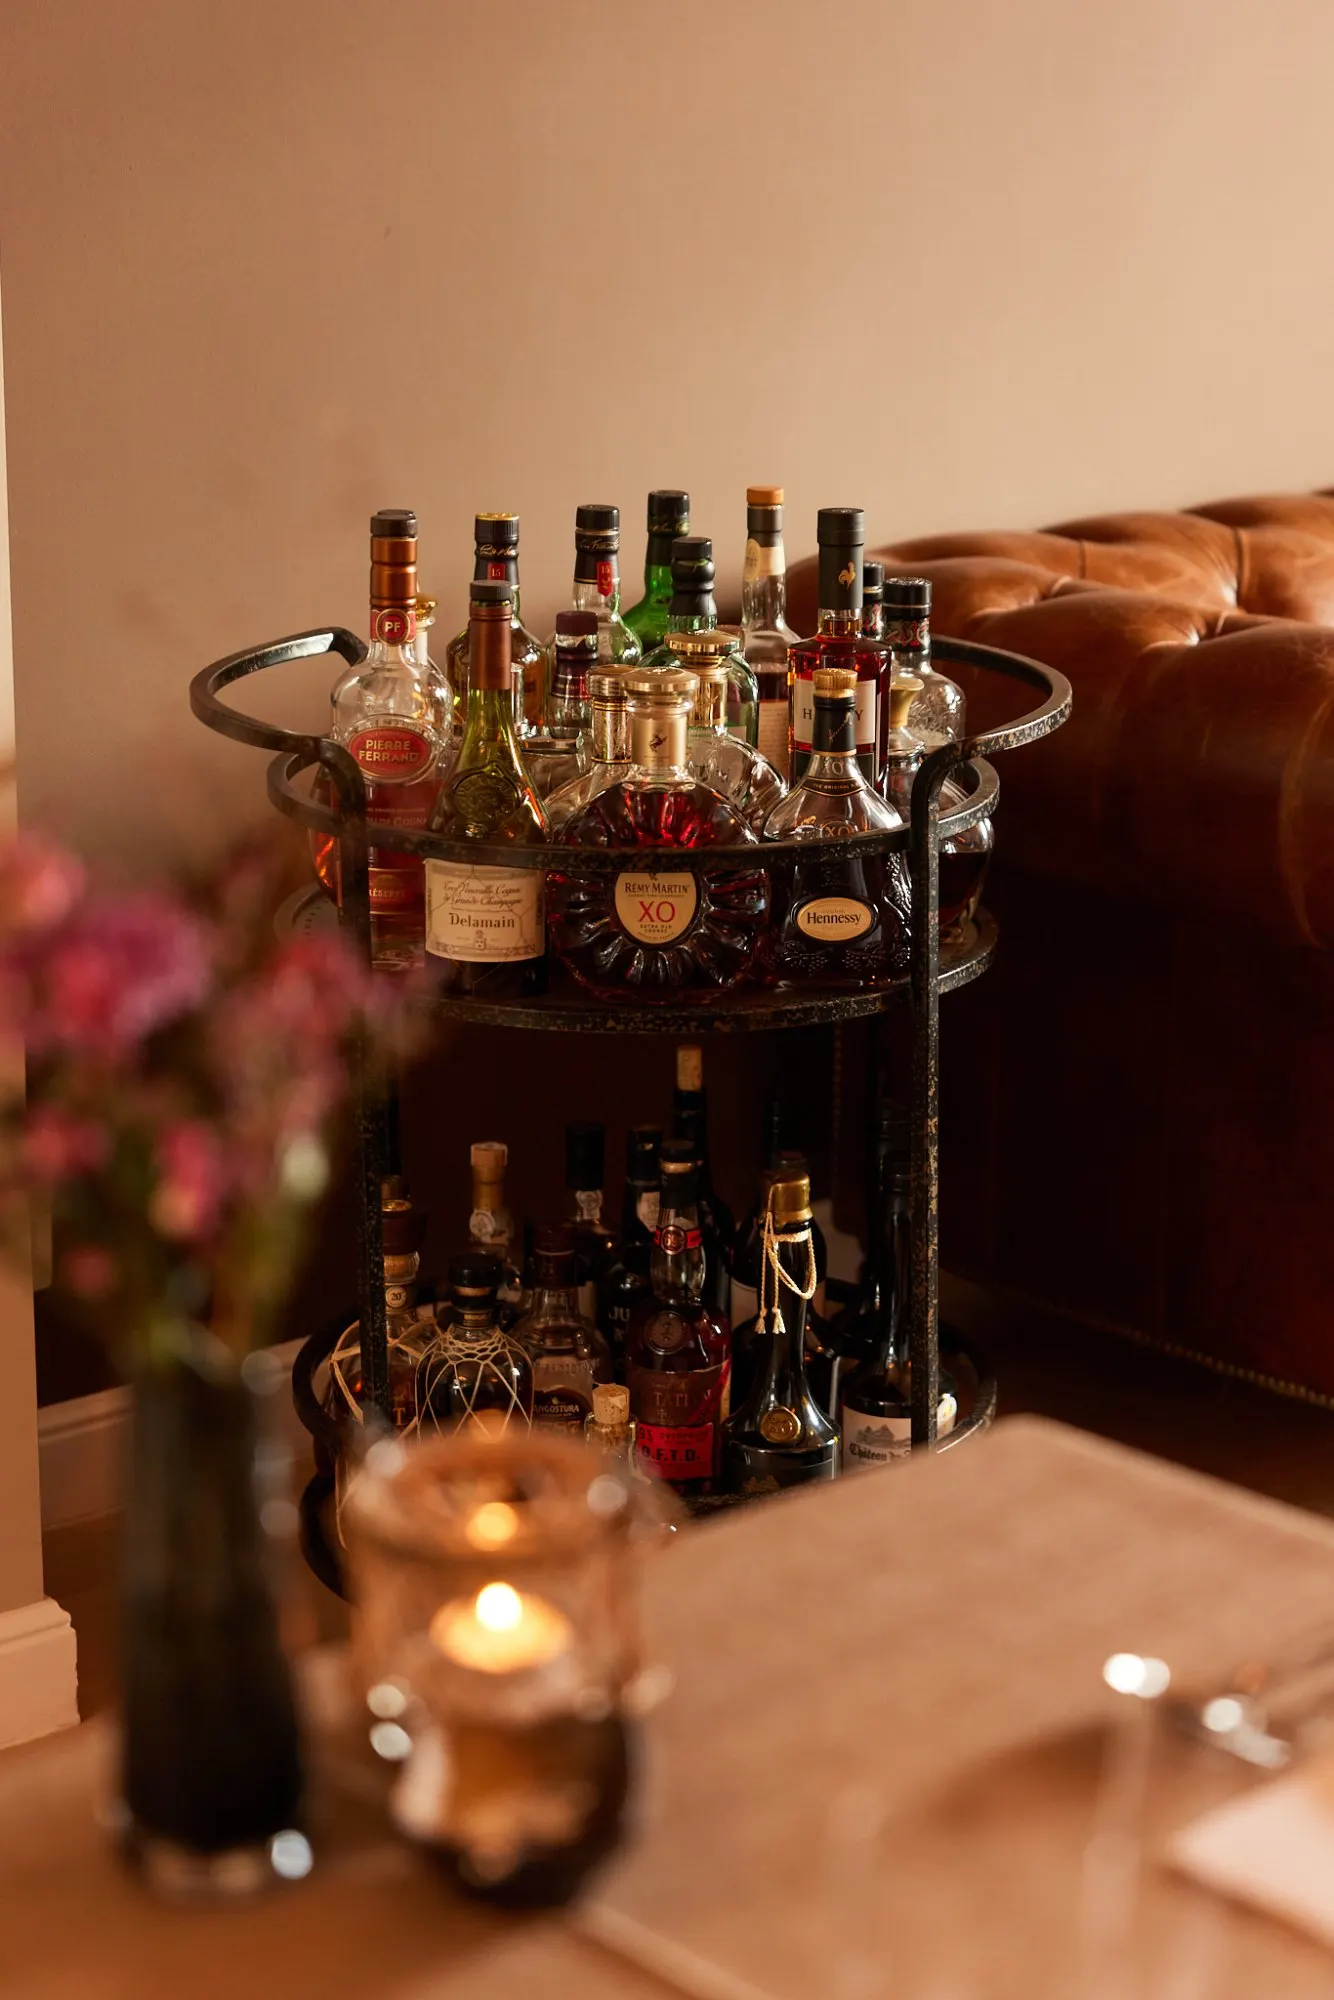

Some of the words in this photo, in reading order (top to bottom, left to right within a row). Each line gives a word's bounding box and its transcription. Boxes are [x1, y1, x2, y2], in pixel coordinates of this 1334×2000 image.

[491, 567, 501, 577] 15
[384, 621, 401, 633] PF
[366, 739, 411, 751] PIERRE
[358, 750, 420, 762] FERRAND
[822, 757, 844, 775] XO
[625, 882, 650, 893] RÉMY
[651, 883, 688, 893] MARTIN
[637, 900, 676, 923] XO
[448, 912, 515, 928] Delamain
[807, 912, 861, 926] Hennessy
[391, 1292, 402, 1301] 20
[534, 1404, 580, 1413] ANGOSTURA
